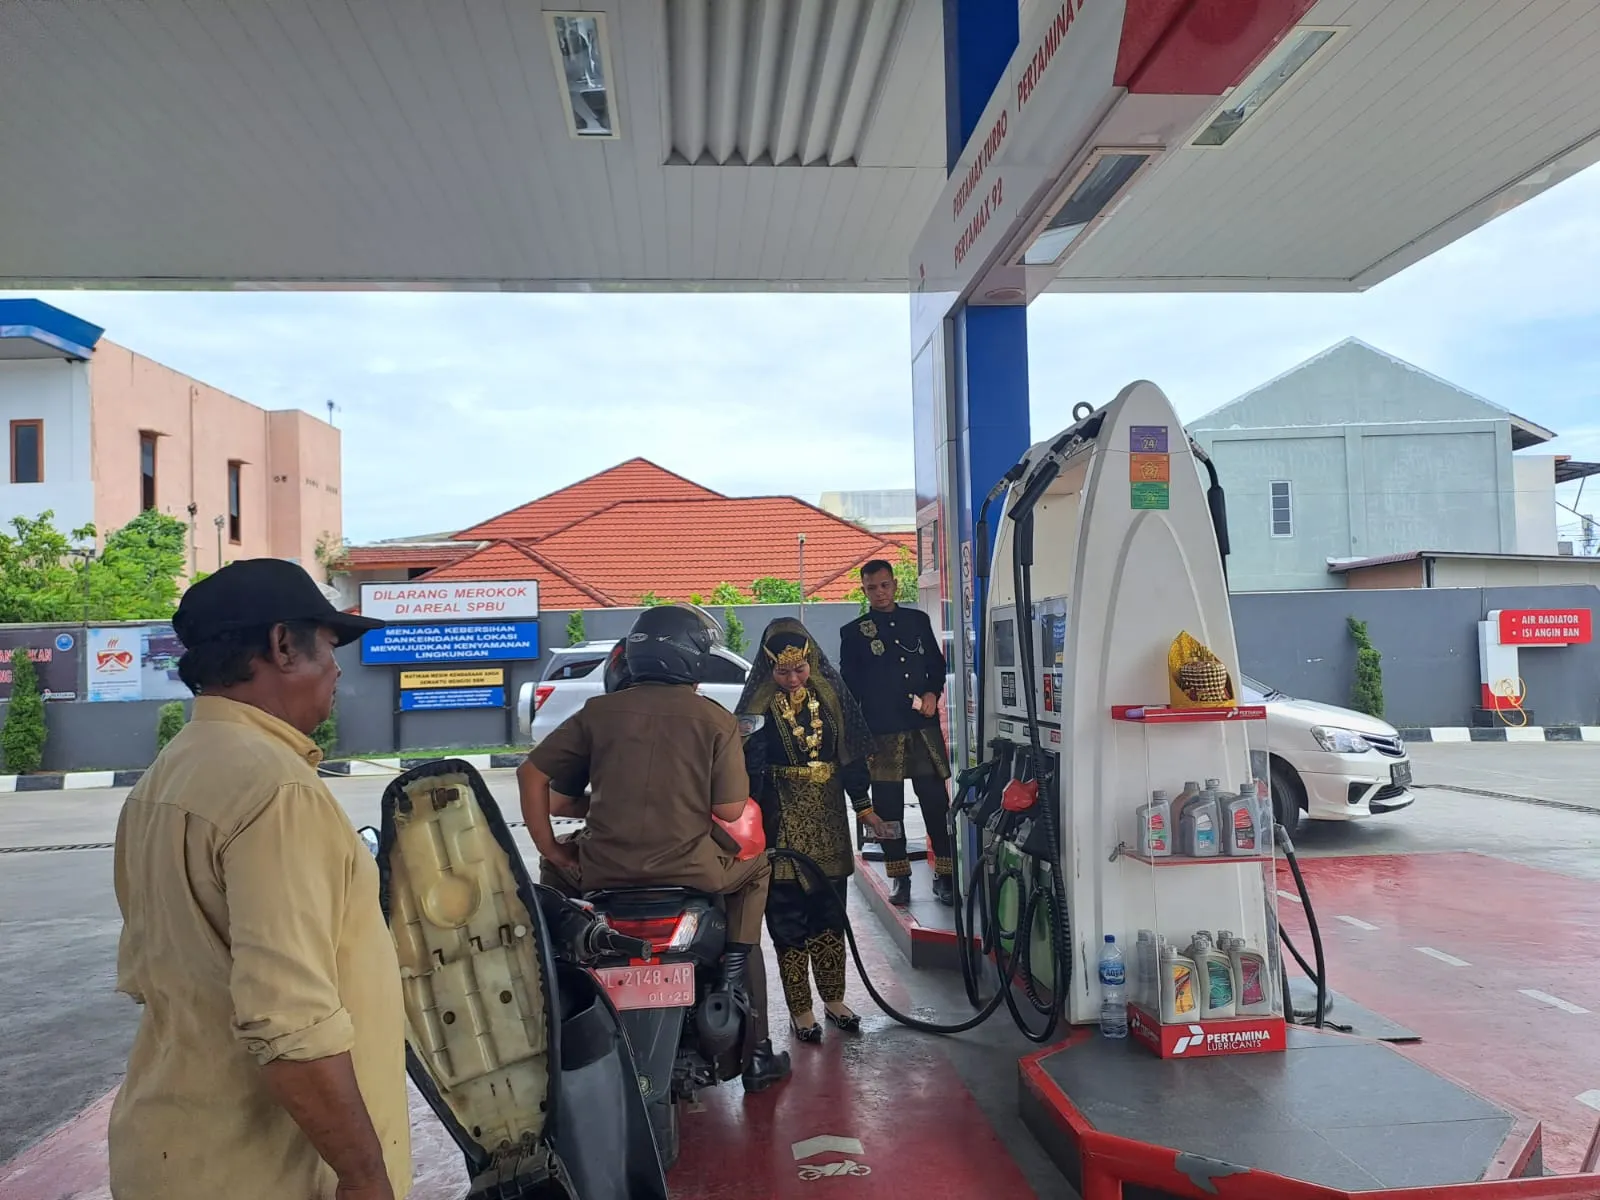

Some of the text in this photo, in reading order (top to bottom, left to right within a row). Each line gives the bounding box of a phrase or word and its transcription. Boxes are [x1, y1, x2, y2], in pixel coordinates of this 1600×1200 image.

[1017, 0, 1075, 113] PERTAMINA
[953, 109, 1008, 223] PERTAMAX TURBO
[954, 175, 1003, 270] PERTAMAX 92
[373, 586, 528, 601] DILARANG MEROKOK
[395, 601, 506, 615] DI AREAL SPBU
[1521, 614, 1579, 625] AIR RADIATOR
[385, 625, 516, 636] MENJAGA KEBERSIHAN
[1522, 628, 1580, 638] ISI ANGIN BAN
[476, 633, 518, 642] LOKASI
[370, 641, 530, 653] MEWUJUDKAN KENYAMANAN
[415, 650, 489, 659] LINGKUNGAN
[624, 969, 662, 987] 2148
[672, 967, 690, 985] AP
[1207, 1030, 1271, 1044] PERTAMINA
[1207, 1040, 1262, 1052] LUBRICANTS
